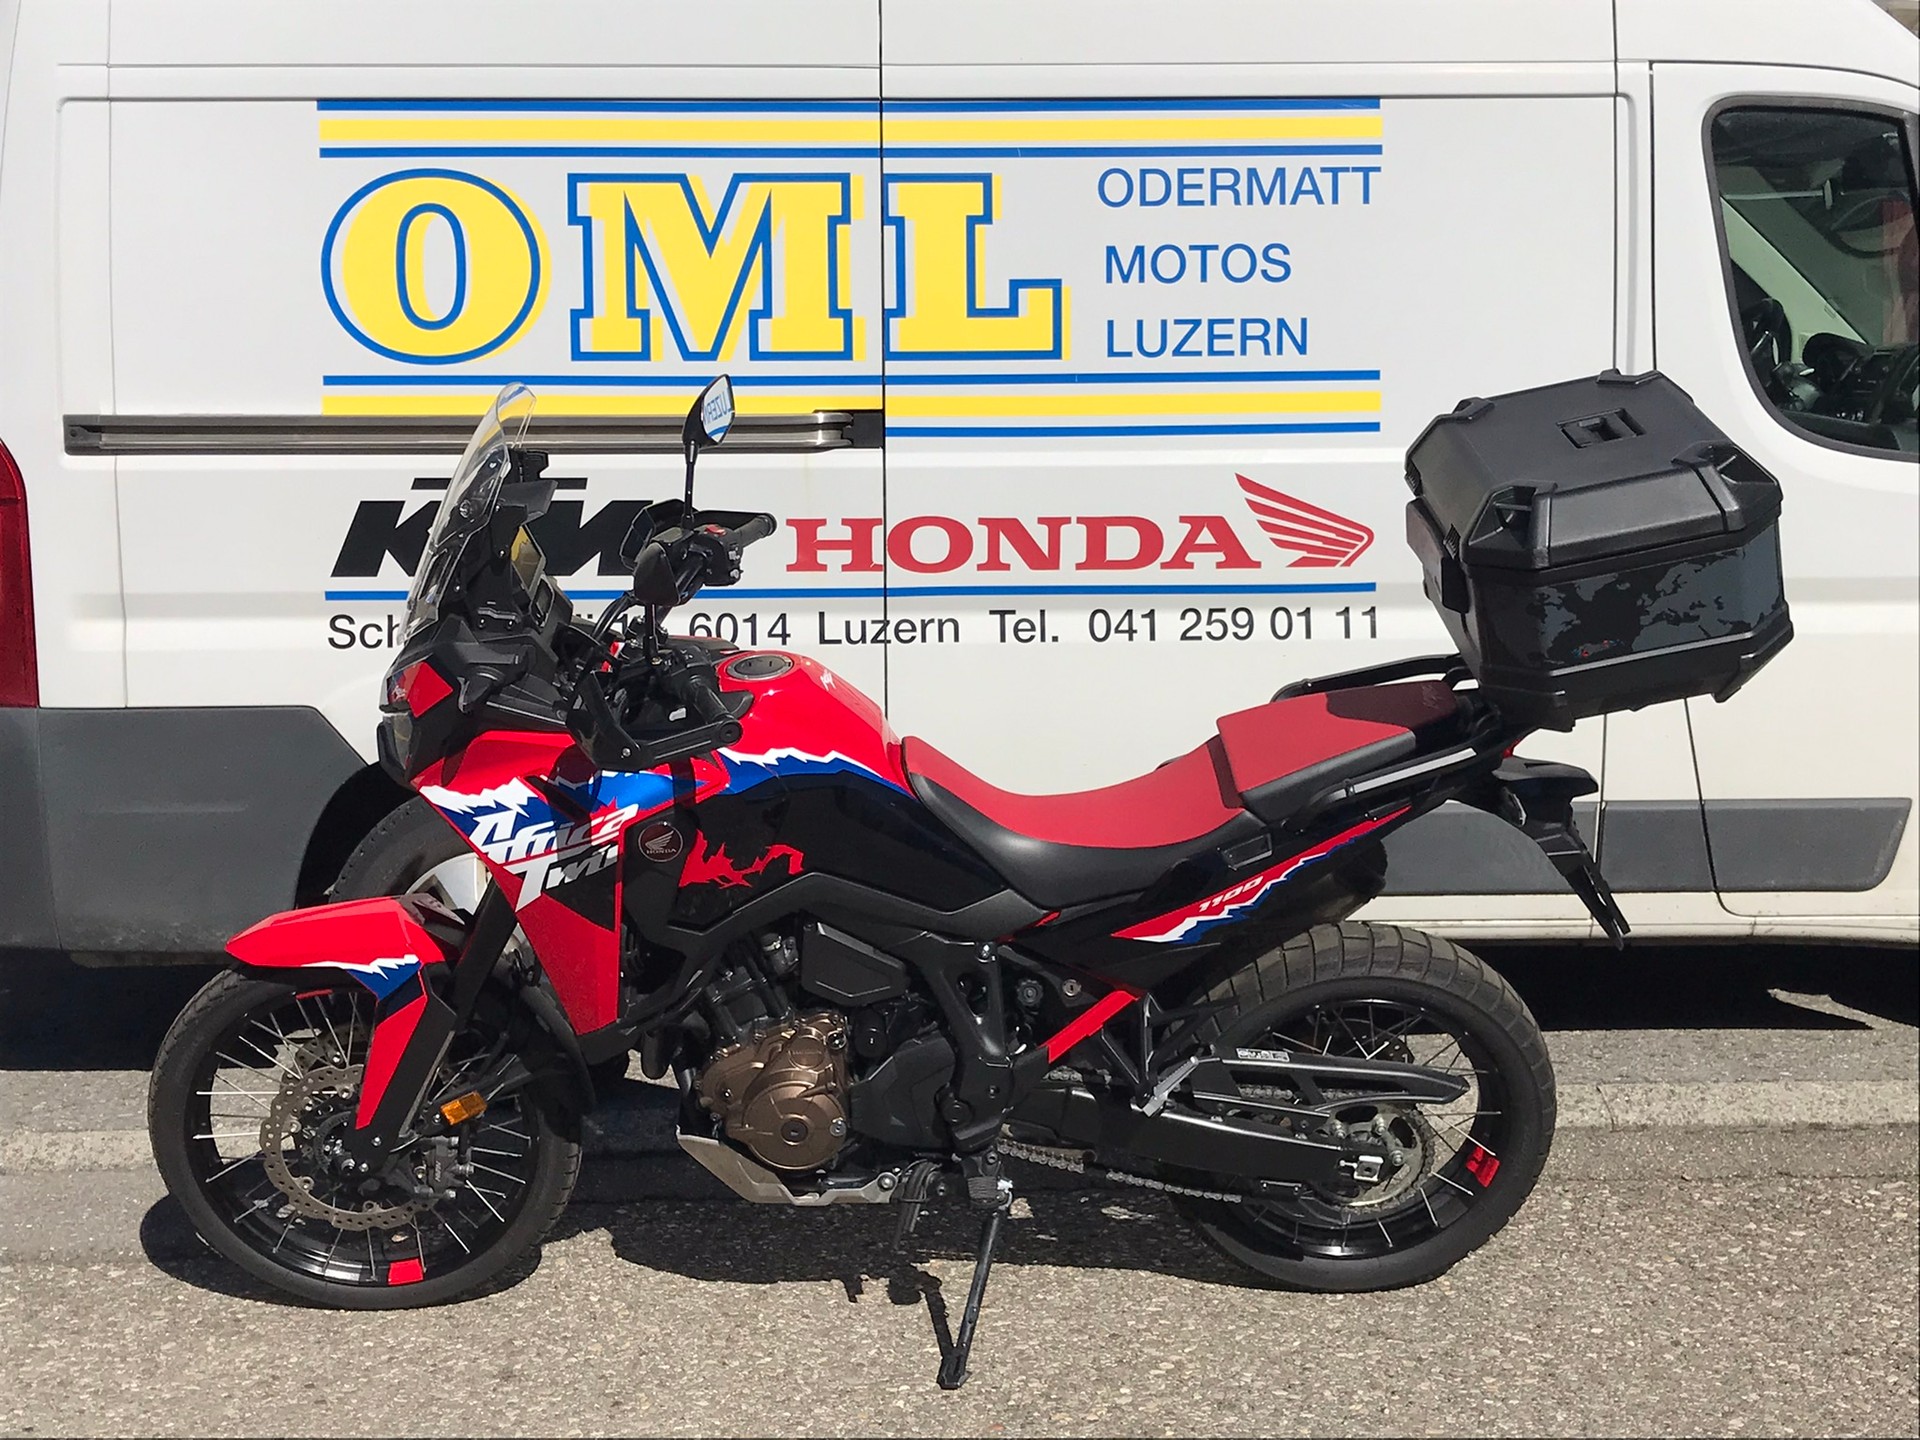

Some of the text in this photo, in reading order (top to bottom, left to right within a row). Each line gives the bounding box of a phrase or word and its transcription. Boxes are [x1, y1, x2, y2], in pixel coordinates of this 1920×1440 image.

[1098, 167, 1382, 208] ODERMATT
[321, 168, 1072, 365] OML
[1105, 243, 1292, 284] MOTOS
[1107, 317, 1308, 358] LUZERN
[331, 478, 653, 577] KM
[786, 516, 1262, 573] HONDA
[689, 605, 1377, 646] 6014 Luzern Tel. 041 259 01 11
[468, 804, 639, 864] Africa
[1199, 876, 1263, 912] 1100
